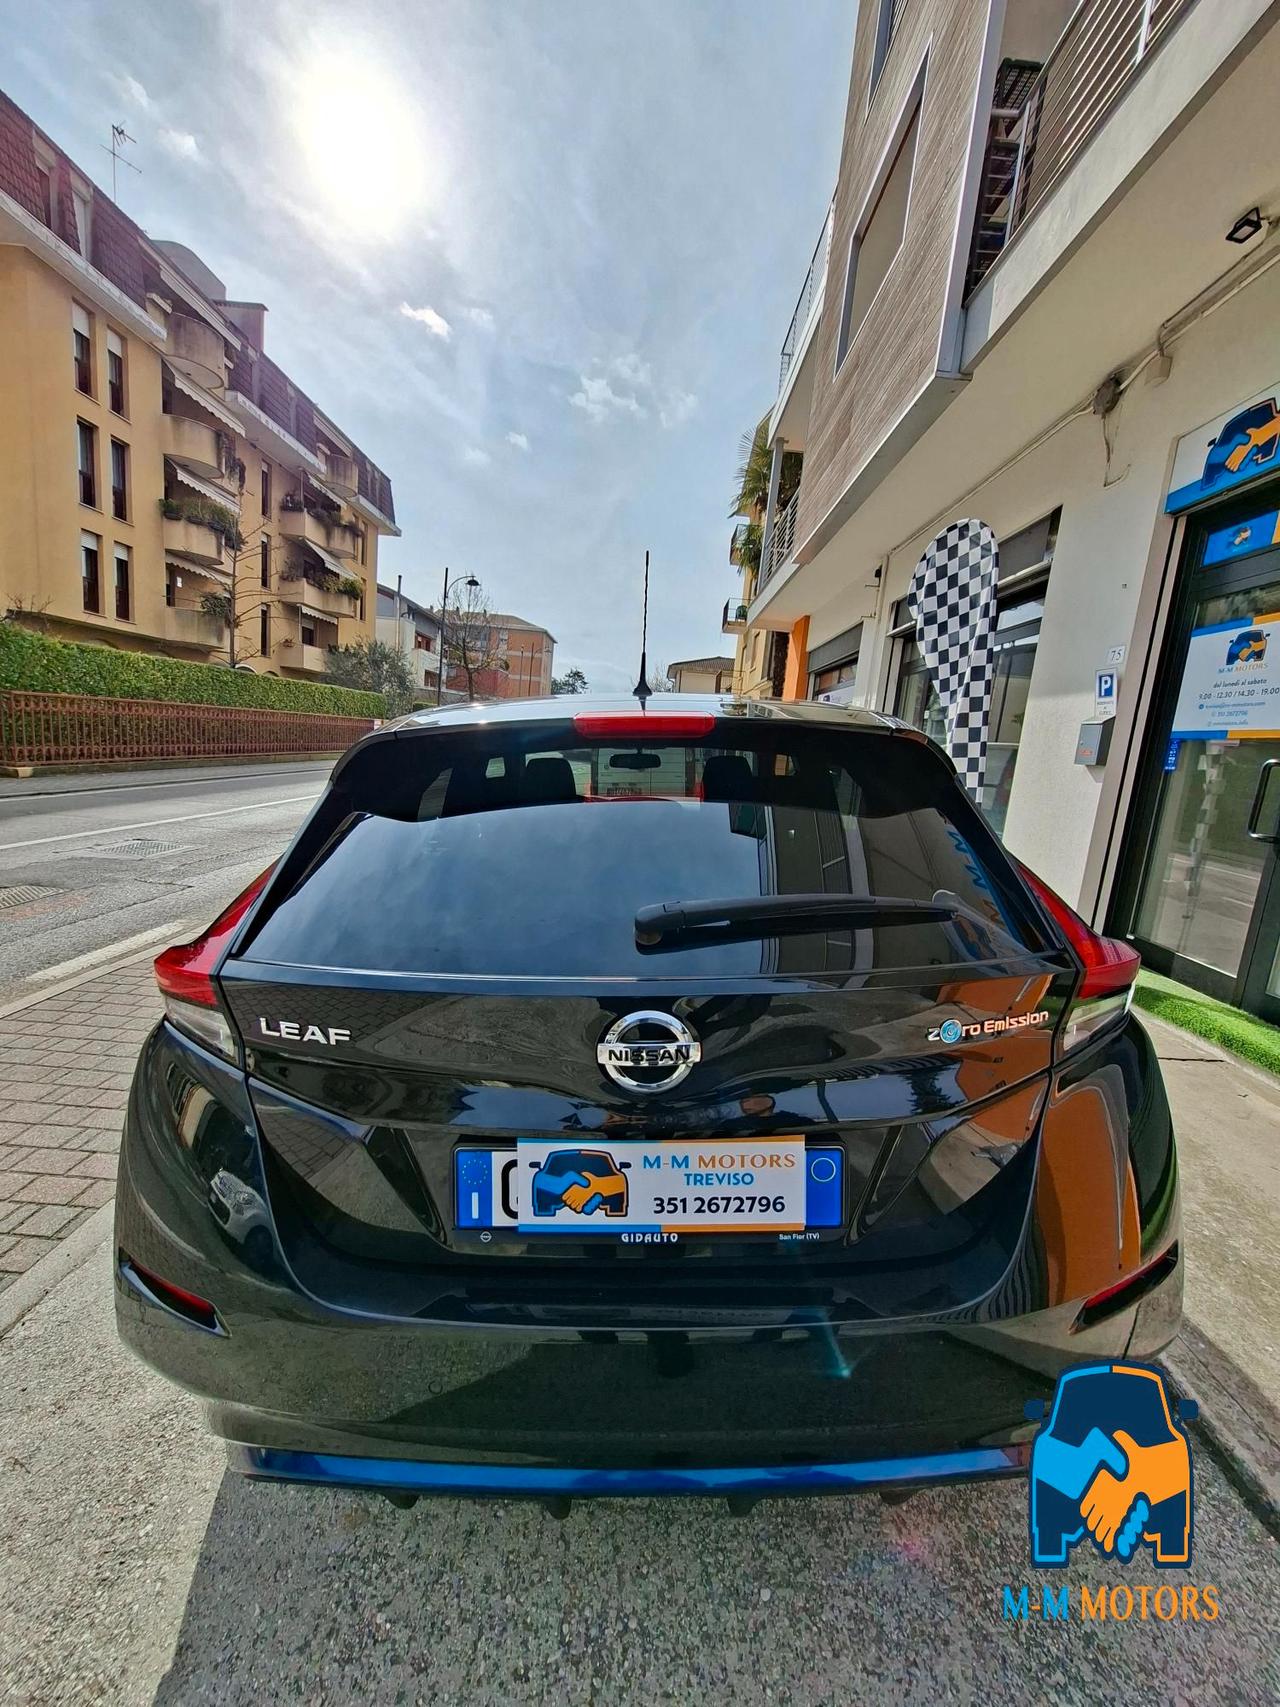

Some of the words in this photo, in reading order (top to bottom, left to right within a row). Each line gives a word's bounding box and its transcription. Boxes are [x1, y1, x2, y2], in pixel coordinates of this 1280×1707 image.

[1111, 649, 1122, 661] 75
[1234, 662, 1269, 673] MOTORS
[1101, 676, 1112, 697] P
[1260, 687, 1280, 696] 19.00
[983, 1011, 1049, 1033] Emission
[259, 1017, 351, 1046] LEAF
[608, 1047, 691, 1062] NISSAN
[643, 1154, 690, 1170] M-M
[698, 1153, 796, 1169] MOTORS
[684, 1172, 754, 1186] TREVISO
[653, 1196, 688, 1214] 351
[693, 1195, 786, 1214] 2672796
[621, 1232, 679, 1243] GIDAUTO
[806, 1231, 820, 1240] (TV)
